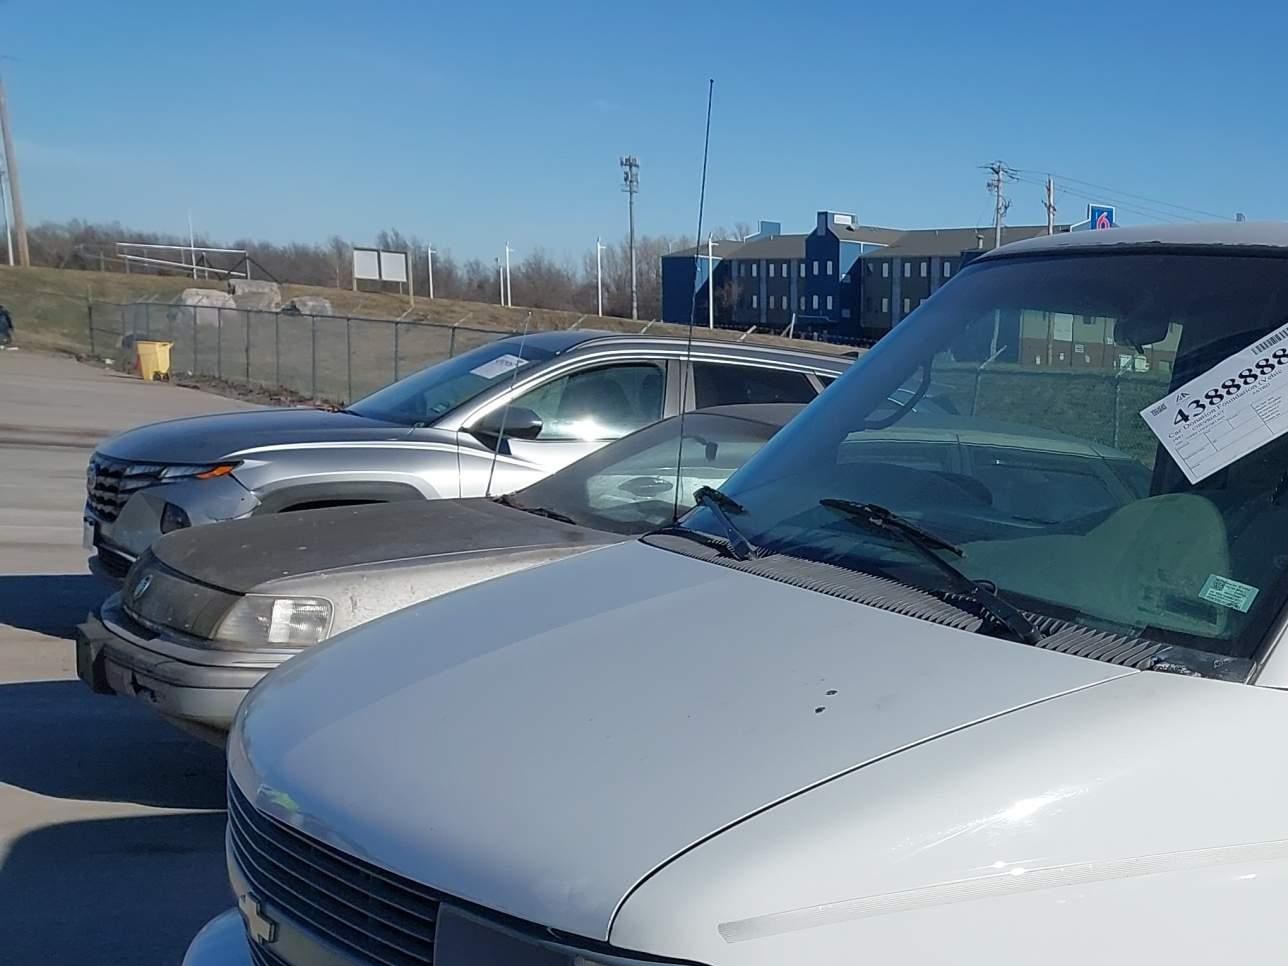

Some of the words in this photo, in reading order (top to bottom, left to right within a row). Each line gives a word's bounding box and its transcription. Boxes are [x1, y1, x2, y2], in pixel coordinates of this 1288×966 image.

[1168, 429, 1182, 439] Car
[1183, 407, 1217, 429] Donation
[1216, 384, 1258, 410] Foundation
